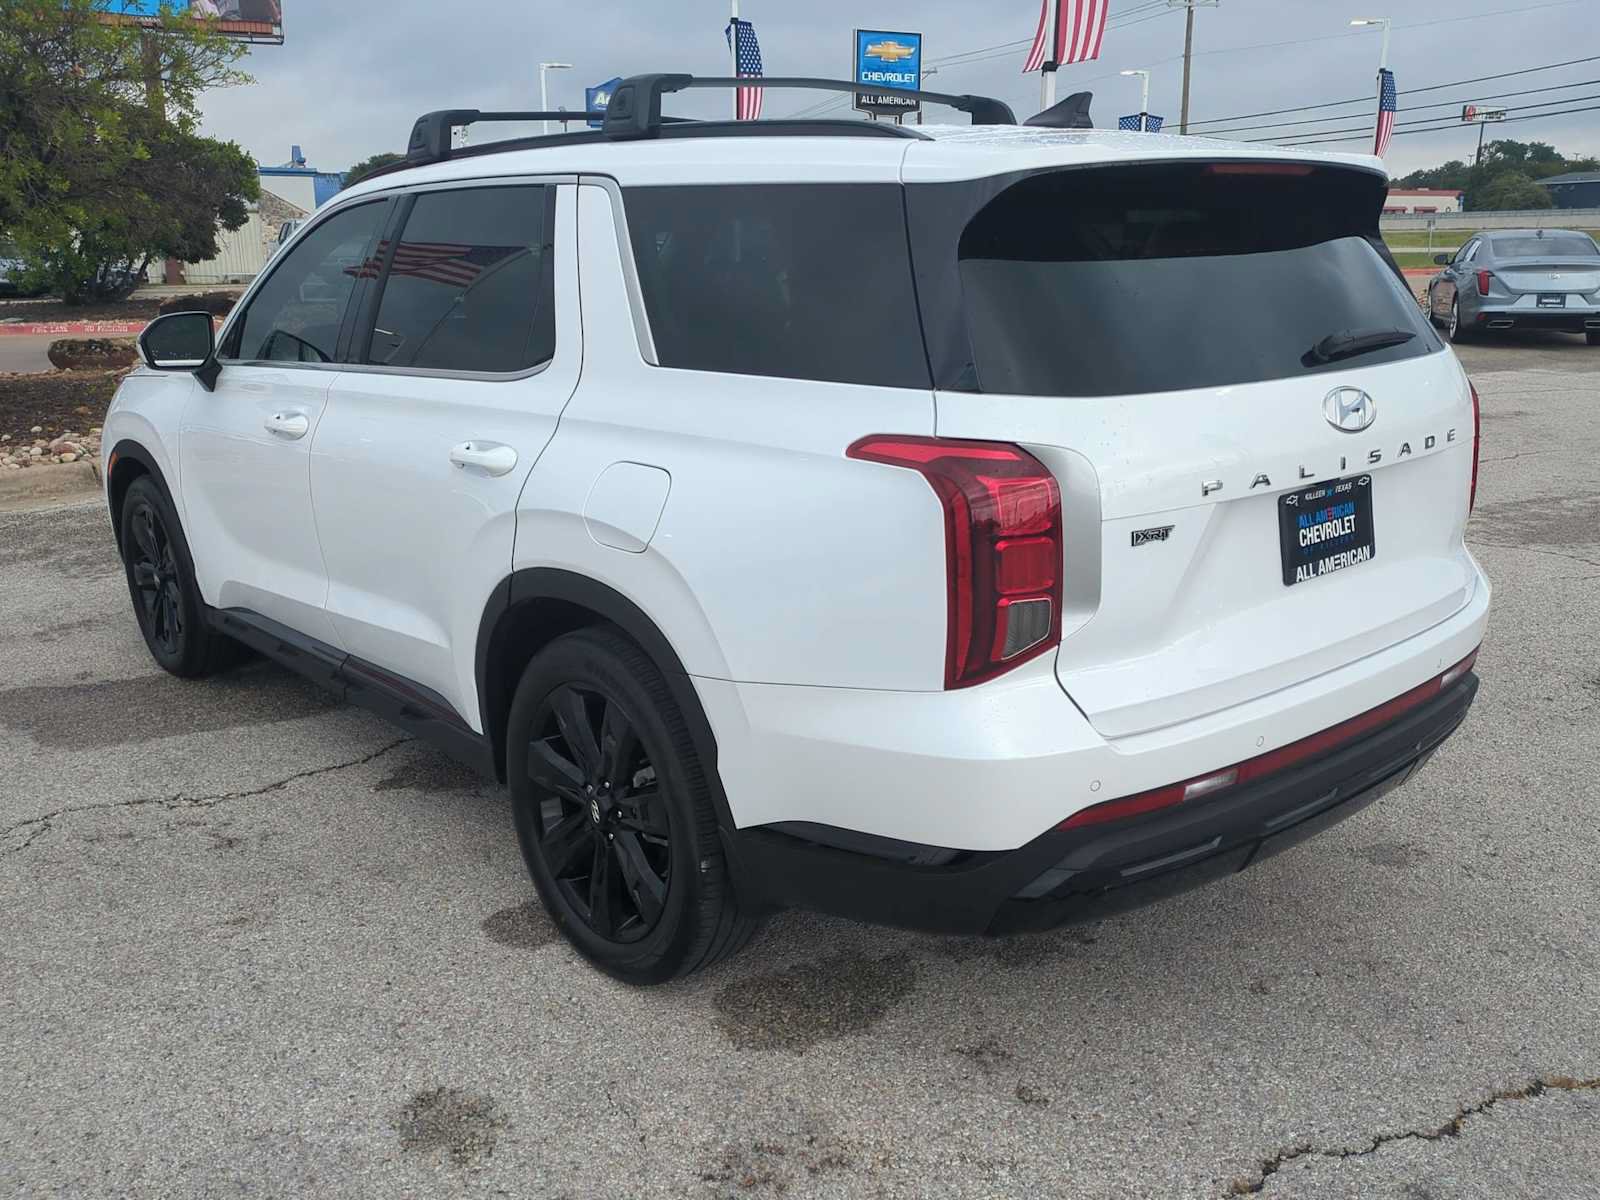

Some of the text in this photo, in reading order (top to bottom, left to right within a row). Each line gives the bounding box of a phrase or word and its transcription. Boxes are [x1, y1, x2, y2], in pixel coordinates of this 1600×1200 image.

[862, 72, 916, 82] CHEVROLET
[861, 95, 916, 106] ALL AMERICAN
[1201, 428, 1456, 497] PALISADE
[1305, 482, 1352, 500] KILLEEN TEXAS
[1299, 502, 1355, 528] ALL AMERICAN
[1299, 515, 1355, 547] CHEVROLET
[1296, 563, 1316, 583] ALL
[1318, 545, 1370, 576] AMERICAN
